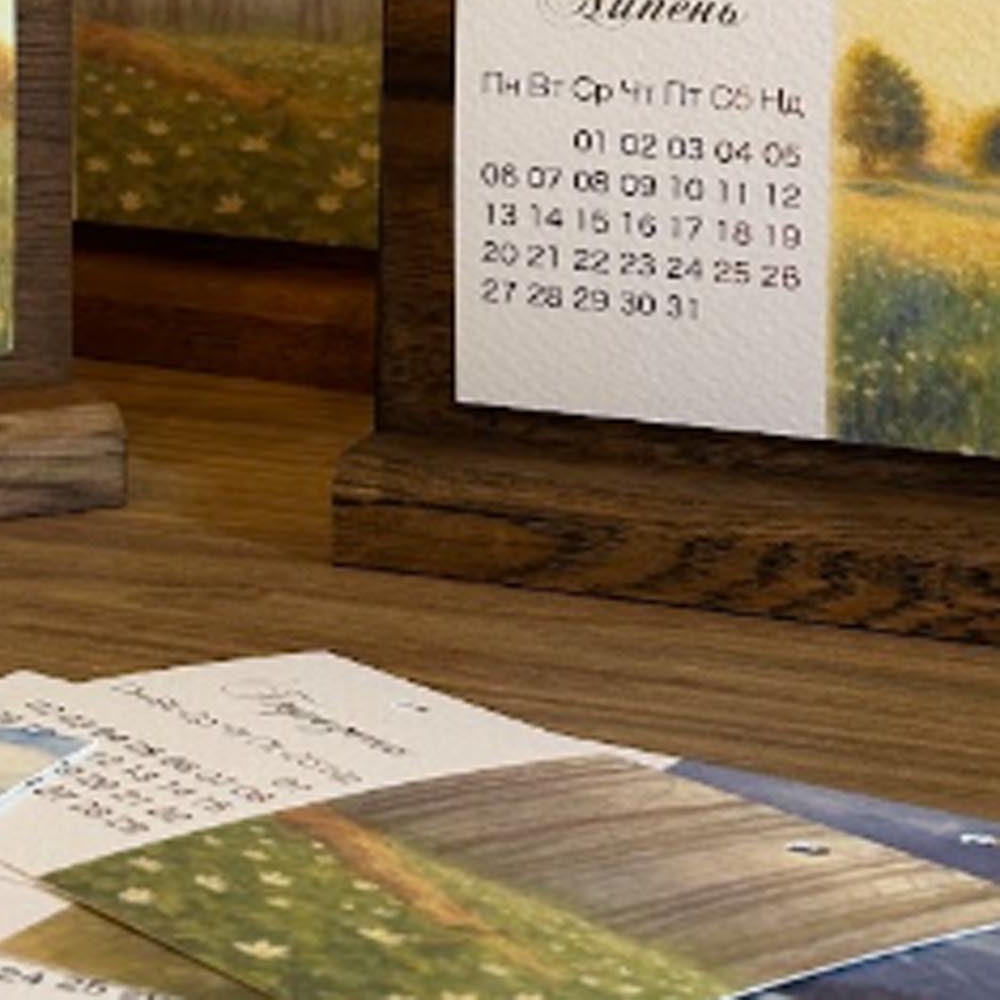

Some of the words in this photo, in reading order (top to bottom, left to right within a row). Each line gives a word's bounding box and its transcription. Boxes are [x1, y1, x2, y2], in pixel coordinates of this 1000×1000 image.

[573, 129, 605, 152] 01
[620, 133, 657, 160] 02
[667, 136, 704, 160] 03
[714, 140, 752, 164] 04
[762, 141, 801, 168] 05
[527, 166, 562, 189] 07
[573, 170, 609, 192] 08
[621, 174, 657, 197] 09
[671, 175, 704, 201] 10
[719, 179, 746, 205] 11
[767, 183, 801, 209] 12
[487, 203, 517, 226] 13
[531, 204, 564, 228] 14
[578, 208, 610, 234] 15
[623, 211, 657, 238] 16
[671, 216, 703, 240] 17
[718, 219, 753, 247] 18
[767, 224, 801, 250] 19
[482, 240, 520, 266] 20
[527, 244, 558, 269] 21
[573, 248, 610, 275] 22
[620, 252, 656, 275] 23
[666, 257, 703, 280] 24
[714, 259, 750, 284] 25
[761, 265, 801, 291] 26
[482, 278, 517, 304] 27
[527, 282, 563, 308] 28
[573, 286, 610, 312] 29
[621, 291, 657, 316] 30
[666, 294, 698, 320] 31
